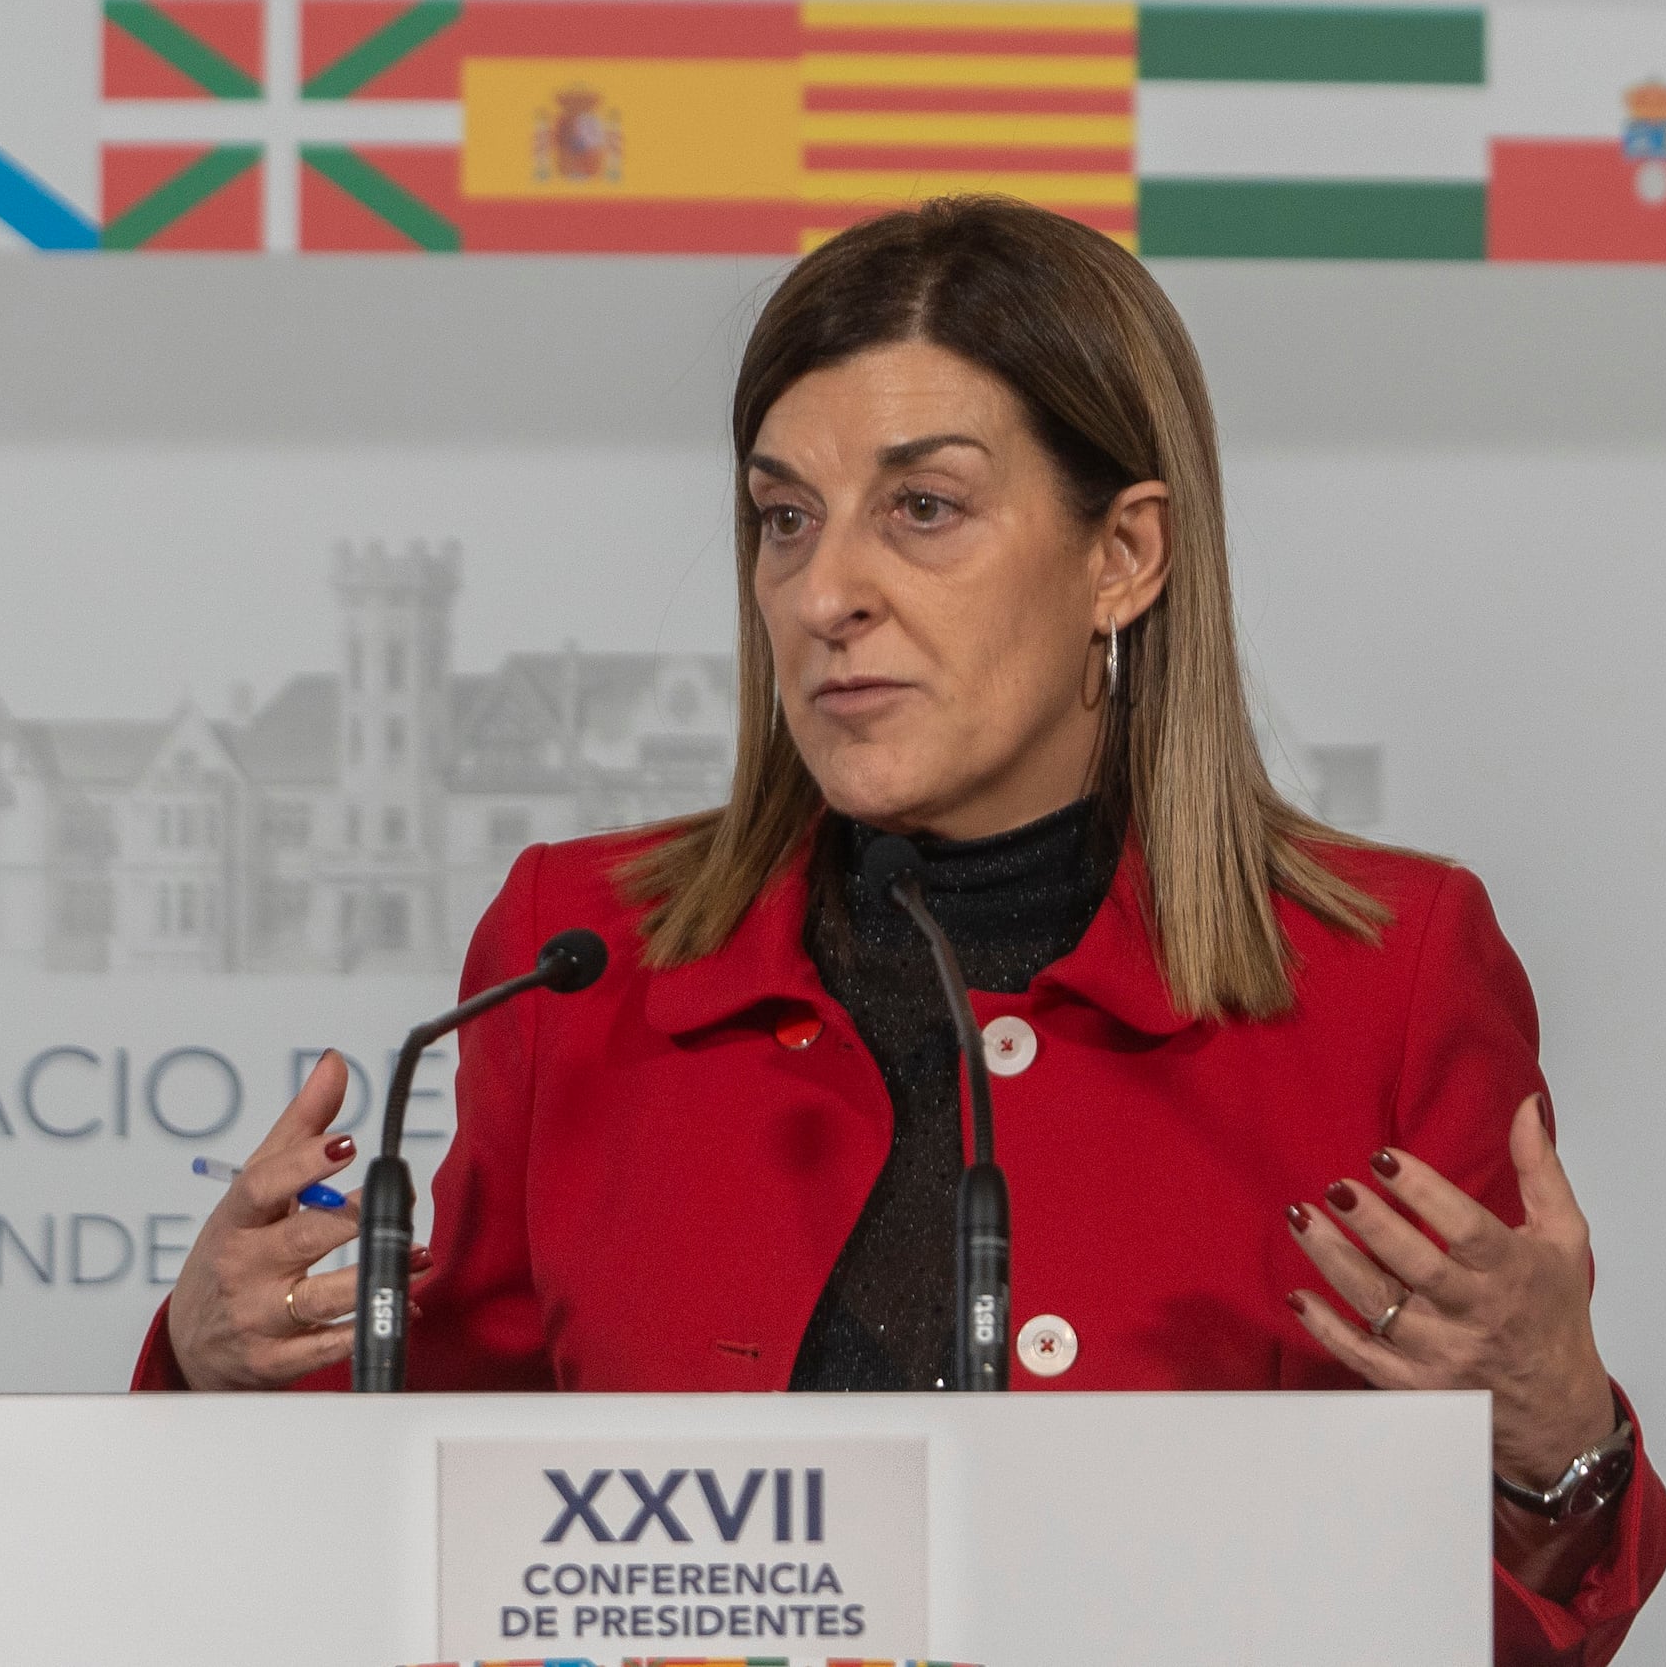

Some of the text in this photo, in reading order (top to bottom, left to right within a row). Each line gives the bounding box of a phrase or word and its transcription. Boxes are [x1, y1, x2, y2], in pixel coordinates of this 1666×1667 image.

[291, 1046, 447, 1139] DE
[541, 1467, 826, 1545] XXVII
[522, 1562, 844, 1598] CONFERENCIA
[500, 1603, 866, 1639] DE PRESIDENTES
